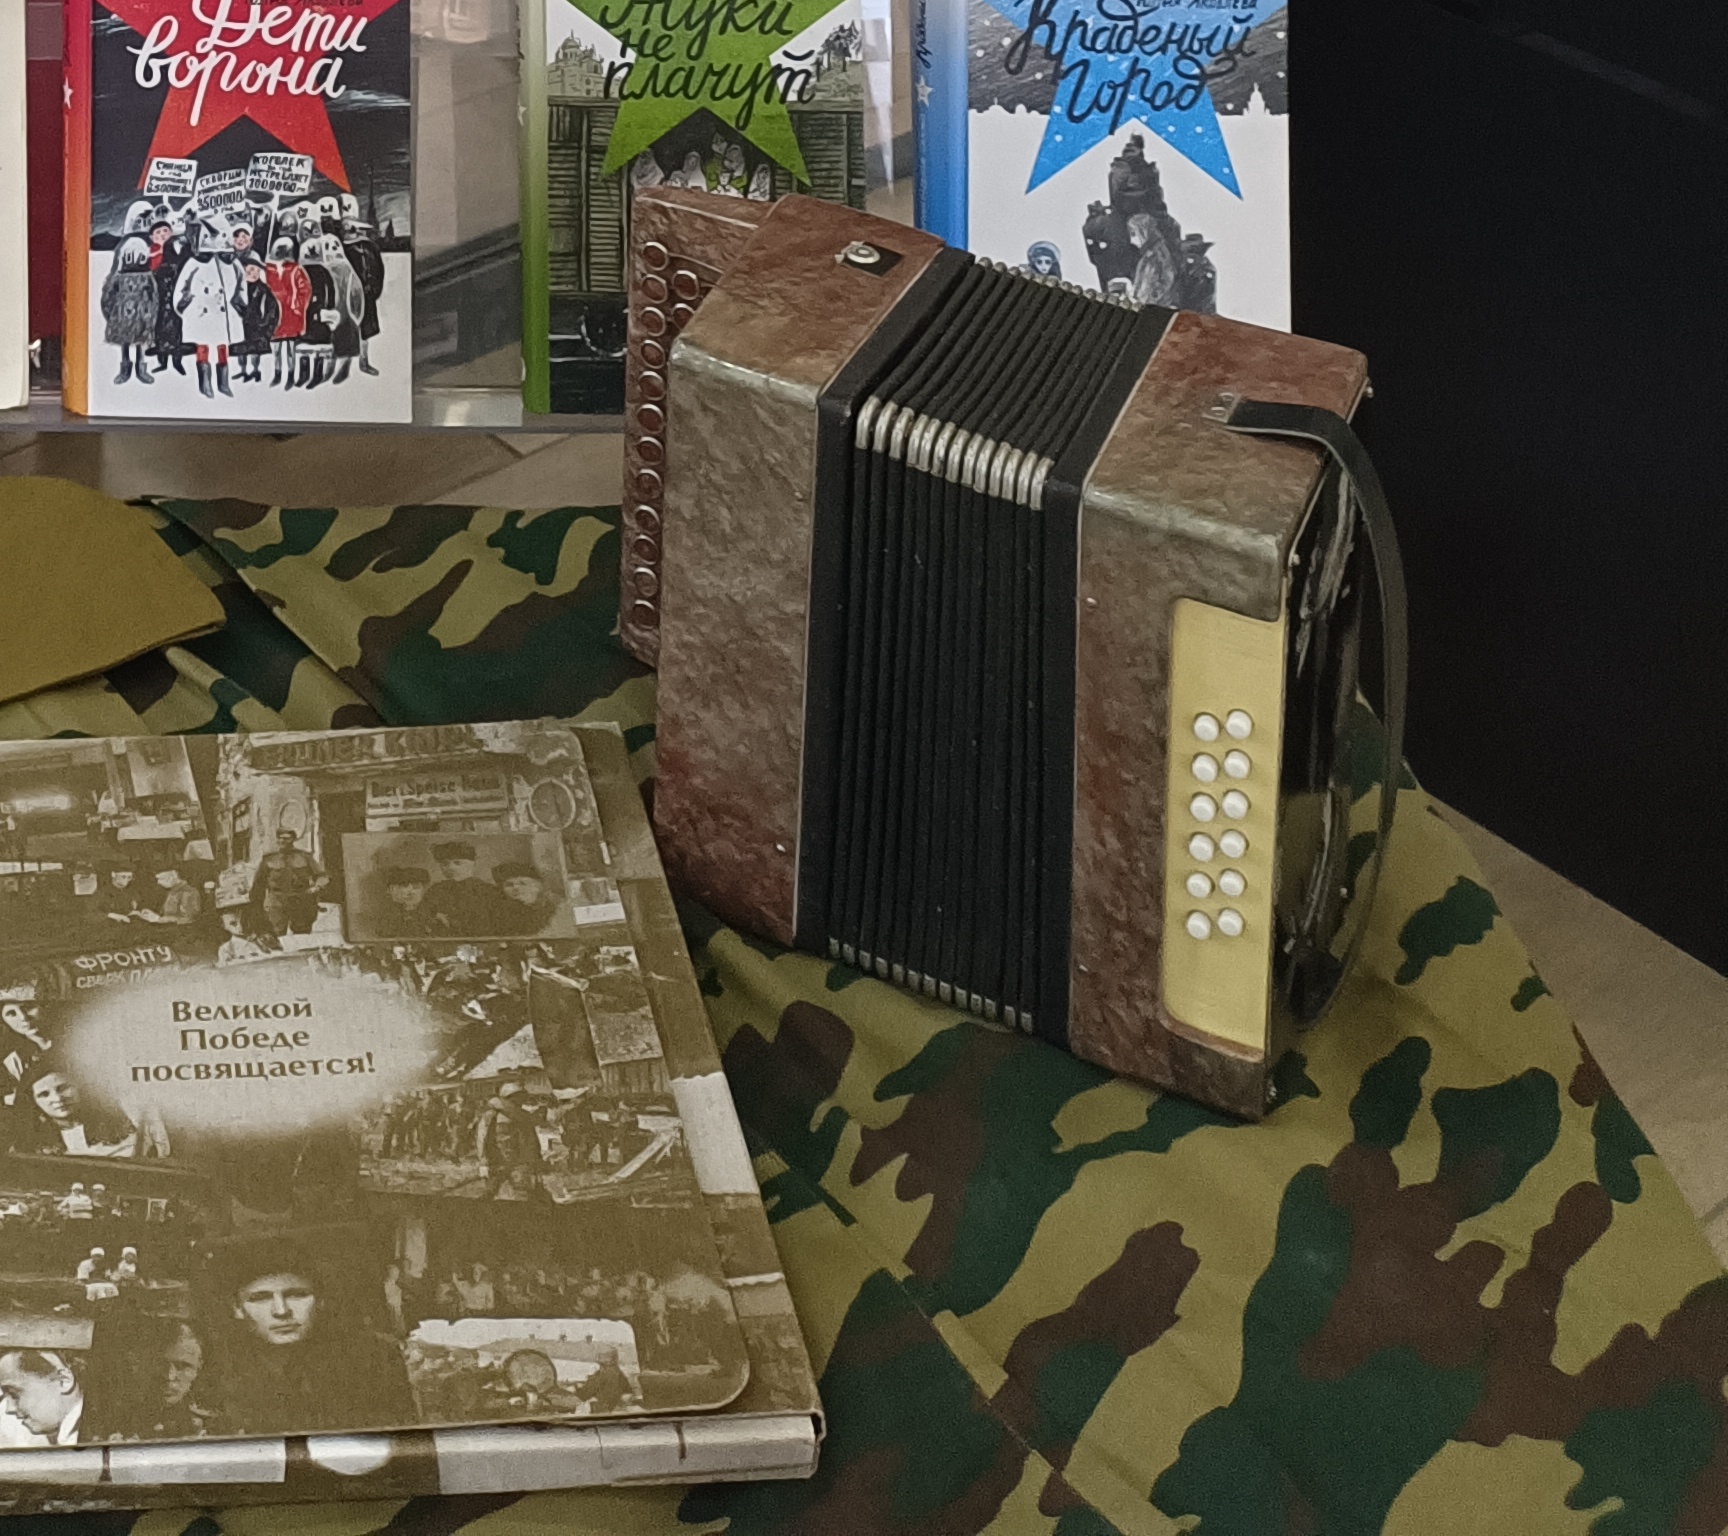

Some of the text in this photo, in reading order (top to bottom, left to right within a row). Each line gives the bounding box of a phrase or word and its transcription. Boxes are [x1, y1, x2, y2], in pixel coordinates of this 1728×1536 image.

[619, 28, 676, 62] не
[125, 14, 348, 128] ворона
[602, 49, 818, 129] плачут
[74, 944, 173, 971] ФРОНТУ
[172, 997, 313, 1023] Великой
[180, 1026, 311, 1052] Победе
[130, 1051, 376, 1083] посвящается!
